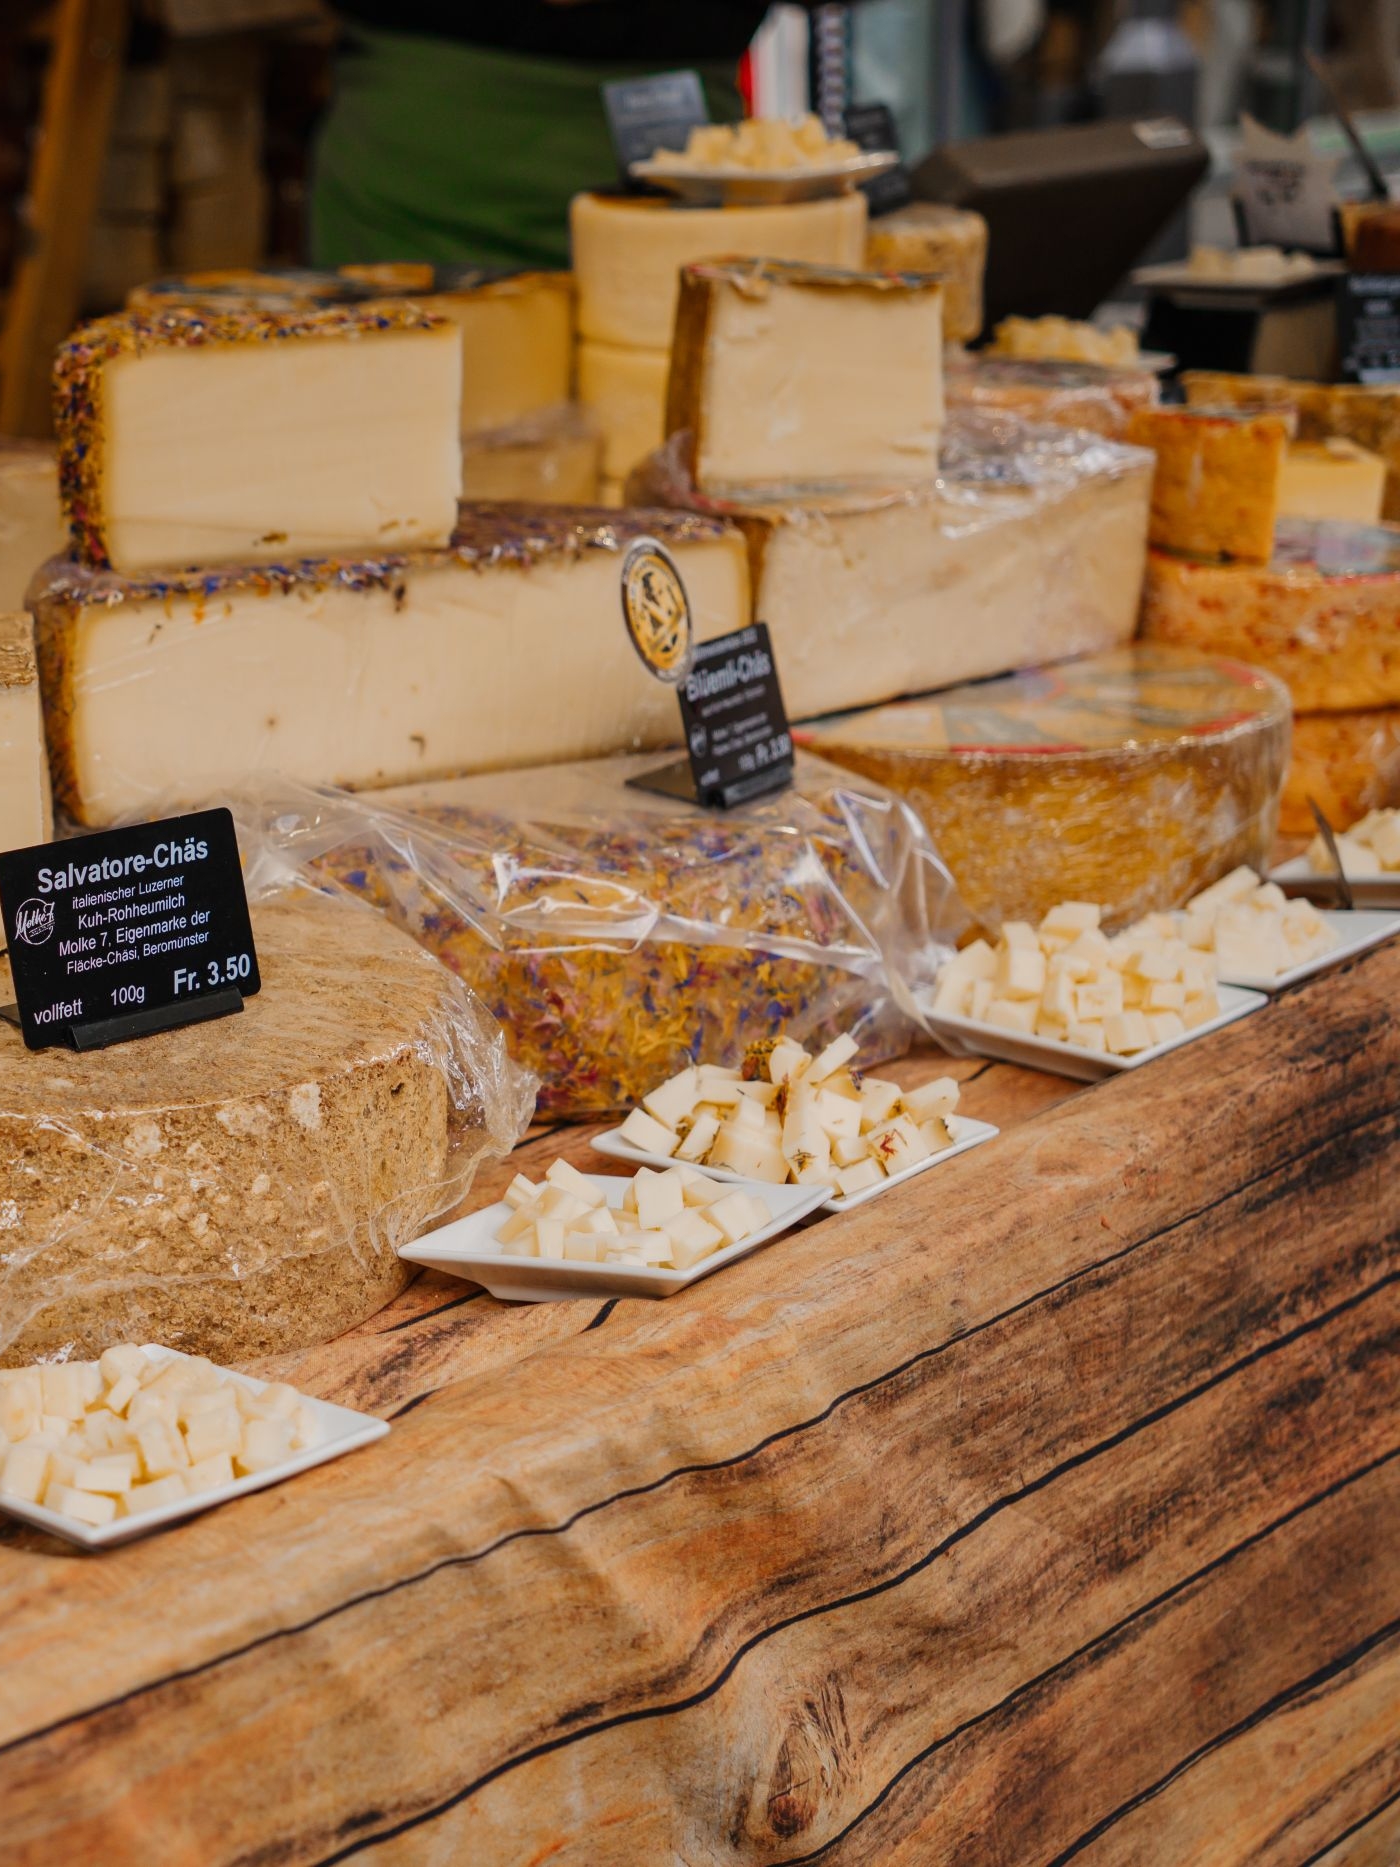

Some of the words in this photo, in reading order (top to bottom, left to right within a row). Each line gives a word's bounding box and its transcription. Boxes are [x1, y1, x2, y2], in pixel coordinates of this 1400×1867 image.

[37, 837, 209, 893] Salvatore-Chäs
[72, 886, 136, 910] italienischer
[138, 874, 185, 896] Luzerner
[78, 893, 185, 930] Kuh-Rohheumilch
[59, 933, 97, 957] Molke
[116, 916, 187, 944] Eigenmarke
[191, 909, 211, 926] der
[67, 946, 140, 975] Fläcke-Chäsi,
[143, 930, 210, 957] Beromünster
[33, 999, 83, 1025] vollfett
[111, 985, 145, 1006] 100g
[173, 969, 200, 994] Fr.
[207, 953, 251, 985] 3.50
